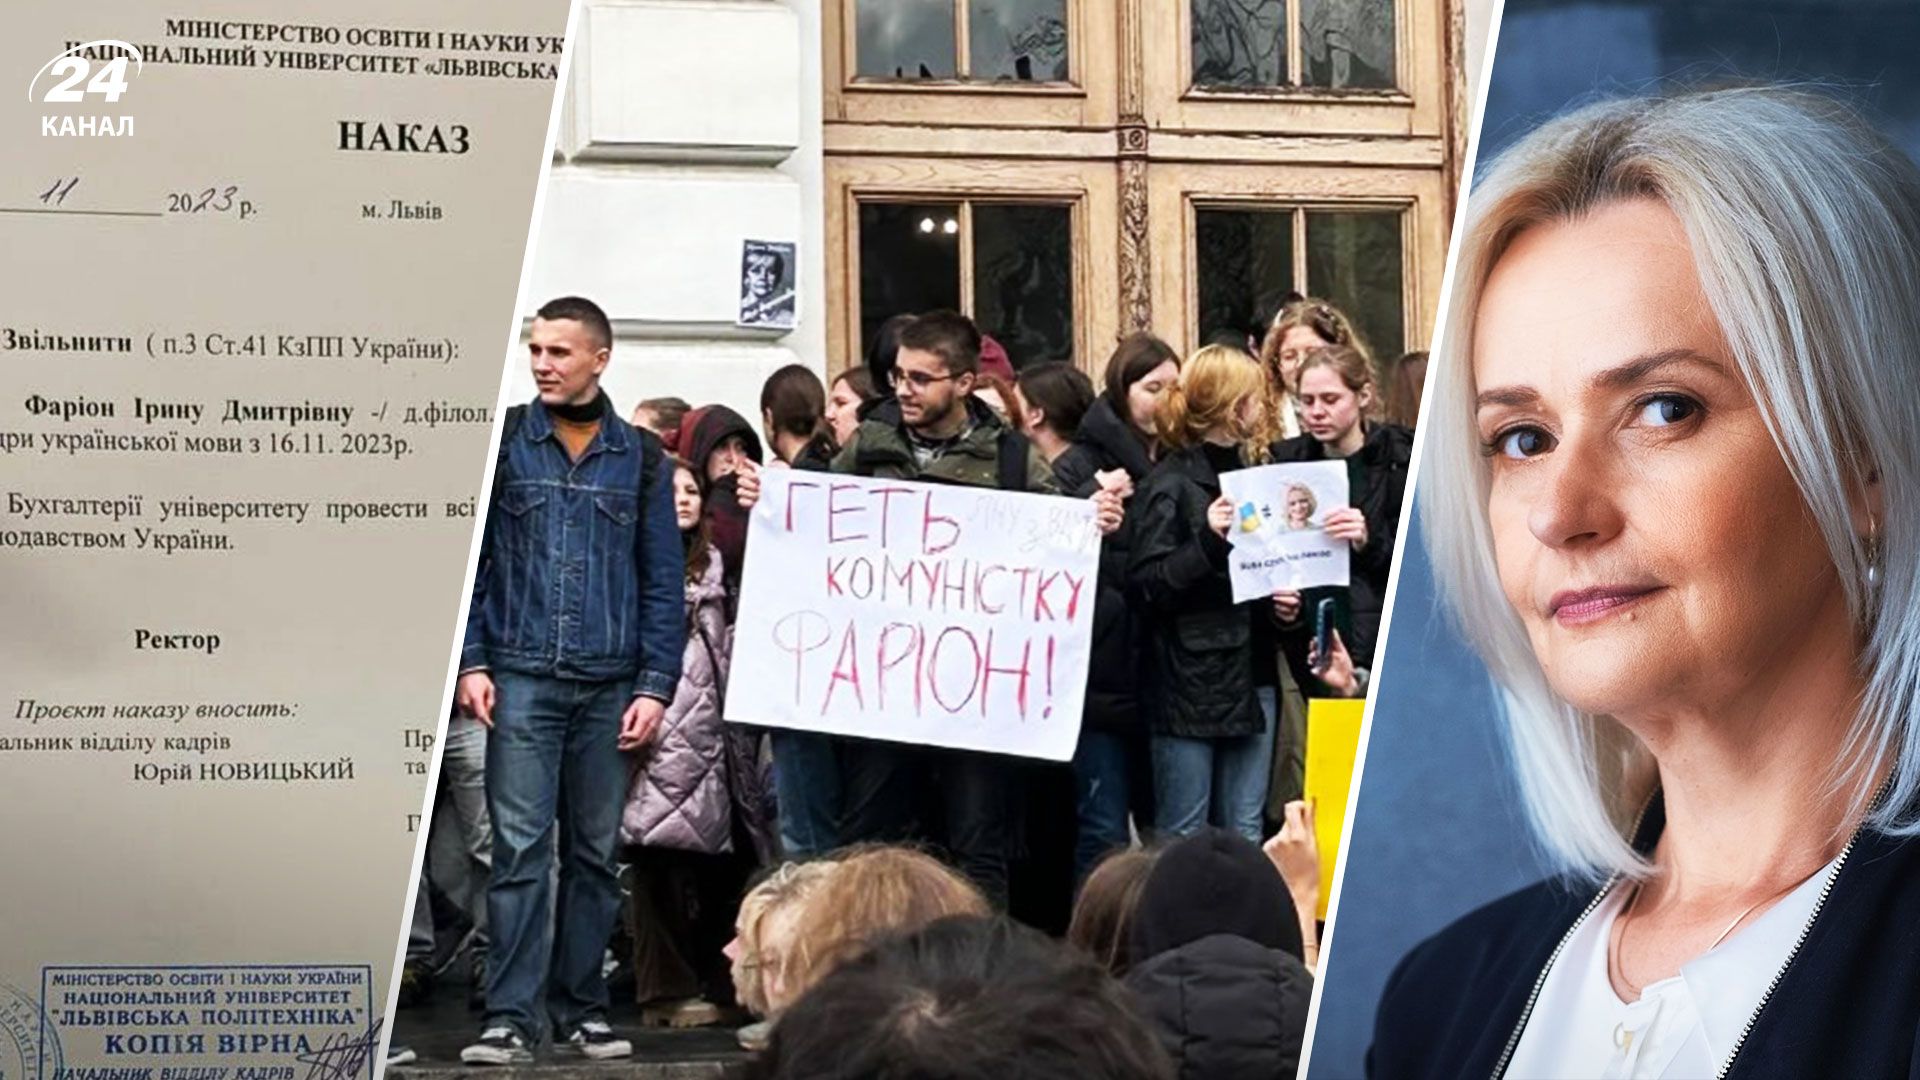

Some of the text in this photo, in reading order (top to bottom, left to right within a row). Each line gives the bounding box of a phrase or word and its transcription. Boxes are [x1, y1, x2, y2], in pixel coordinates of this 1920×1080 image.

[165, 19, 341, 47] МІНІСТЕРСТВО
[346, 28, 431, 50] ОСВІТИ
[438, 33, 444, 49] І
[451, 33, 530, 53] НАУКИ
[65, 41, 258, 68] НАЦІОНАЛЬНИЙ
[263, 49, 421, 75] УНІВЕРСИТЕТ
[339, 121, 469, 154] НАКАЗ
[240, 201, 257, 219] р.
[363, 205, 381, 218] м.
[388, 200, 442, 220] Львів
[3, 329, 131, 352] Звільнити
[206, 334, 265, 356] Ст.41
[278, 336, 343, 357] КзПП
[352, 337, 458, 364] України):
[25, 395, 114, 422] Фаріон
[135, 397, 203, 425] Ірину
[222, 400, 353, 427] Дмитрівну
[42, 429, 178, 455] української
[185, 437, 242, 453] мови
[342, 433, 412, 460] 2023р.
[8, 492, 475, 524] Бухгалтерії університету провести всі
[784, 481, 961, 555] ГЕТЬ
[134, 528, 233, 555] України.
[827, 555, 1084, 622] КОМУНІСТКУ
[136, 630, 220, 654] Ректор
[772, 609, 1055, 722] ФАРІОН!
[16, 700, 299, 724] Проєкт наказу вносить:
[81, 733, 155, 754] відділу
[164, 732, 230, 754] кадрів
[405, 729, 435, 752] Пр
[135, 757, 353, 785] Юрій НОВИЦЬКИЙ
[404, 762, 426, 774] та
[52, 973, 163, 987] МІНІСТЕРСТВО
[169, 972, 225, 987] ОСВІТИ
[241, 972, 292, 986] НАУКИ
[298, 970, 363, 986] УКРАЇНИ
[63, 989, 351, 1006] НАЦІОНАЛЬНИЙ УНІВЕРСИТЕТ
[202, 1008, 363, 1025] ПОЛІТЕХНІКА"
[106, 1034, 313, 1056] КОПІЯ ВІРНА
[234, 1067, 294, 1080] КАДРІВ
